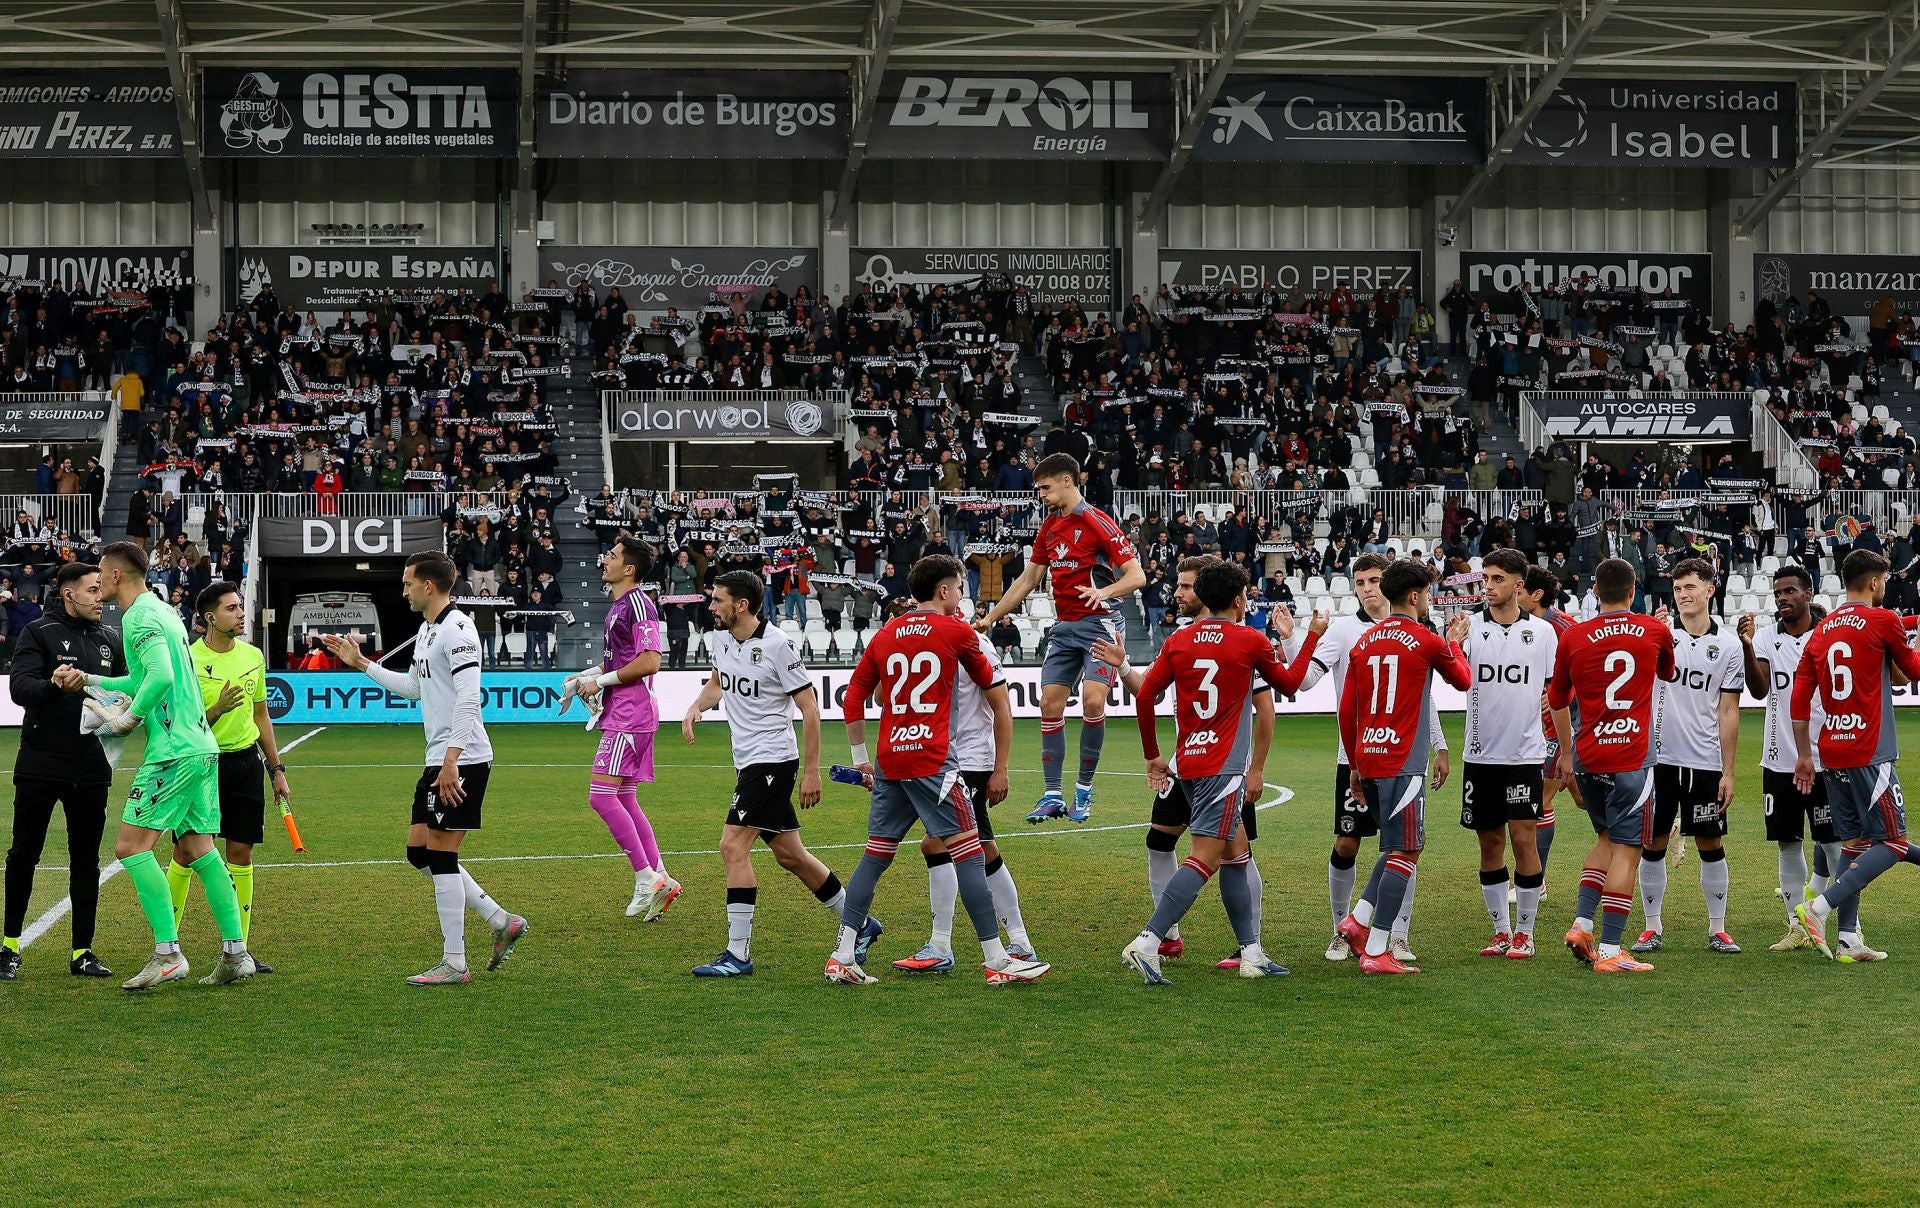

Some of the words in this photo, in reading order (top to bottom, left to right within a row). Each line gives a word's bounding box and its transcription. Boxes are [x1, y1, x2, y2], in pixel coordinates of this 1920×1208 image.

[104, 87, 174, 103] ARIDOS
[889, 77, 1149, 131] BEROIL
[1610, 88, 1778, 111] Universidad
[550, 91, 652, 125] Diario
[662, 91, 704, 125] de
[716, 93, 836, 136] Burgos
[1283, 96, 1467, 133] CaixaBank
[303, 133, 363, 146] Reciclaje
[366, 133, 381, 146] de
[385, 133, 431, 146] aceites
[434, 133, 494, 147] vegetales
[1033, 134, 1107, 154] Energía
[1611, 123, 1750, 158] Isabel
[1772, 125, 1778, 158] I
[289, 256, 380, 278] DEPUR
[391, 256, 495, 278] ESPAÑA
[925, 254, 998, 270] SERVICIOS
[1008, 253, 1111, 270] INMOBILIARIOS
[598, 258, 676, 303] Bosque
[680, 258, 782, 288] Encantado
[1014, 275, 1045, 289] 947
[1048, 275, 1081, 289] 008
[1201, 264, 1299, 290] PABLO
[1312, 265, 1413, 290] PEREZ
[1469, 258, 1692, 294] rotucolor
[5, 410, 23, 419] DE
[29, 410, 104, 419] SEGURIDAD
[1580, 402, 1696, 415] AUTOCARES
[1545, 415, 1735, 435] RAMILA
[410, 471, 433, 479] BURGOS
[535, 476, 554, 485] BURGOS
[631, 488, 647, 496] BURGOS
[1777, 487, 1809, 495] BURGOS
[1282, 496, 1320, 508] BURGOSCF
[680, 519, 699, 527] BURGOS
[850, 529, 874, 537] BURGOS
[302, 518, 402, 554] DIGI
[1437, 596, 1478, 605] BURGOSCF
[896, 624, 932, 639] MORCI
[1586, 624, 1645, 644] LORENZO
[1822, 615, 1866, 637] PACHECO
[1193, 632, 1224, 645] JOGO
[1359, 640, 1369, 651] V.
[1369, 628, 1421, 652] VALVERDE
[1478, 664, 1529, 685] DIGI
[1604, 650, 1636, 710] 2
[1827, 641, 1853, 700] 6
[720, 672, 759, 698] DIGI
[886, 651, 941, 715] 22
[1193, 659, 1220, 720] 3
[1366, 654, 1400, 715] 11
[1598, 737, 1631, 746] ENERGÍA
[1464, 781, 1474, 804] 2
[1893, 784, 1904, 807] 6
